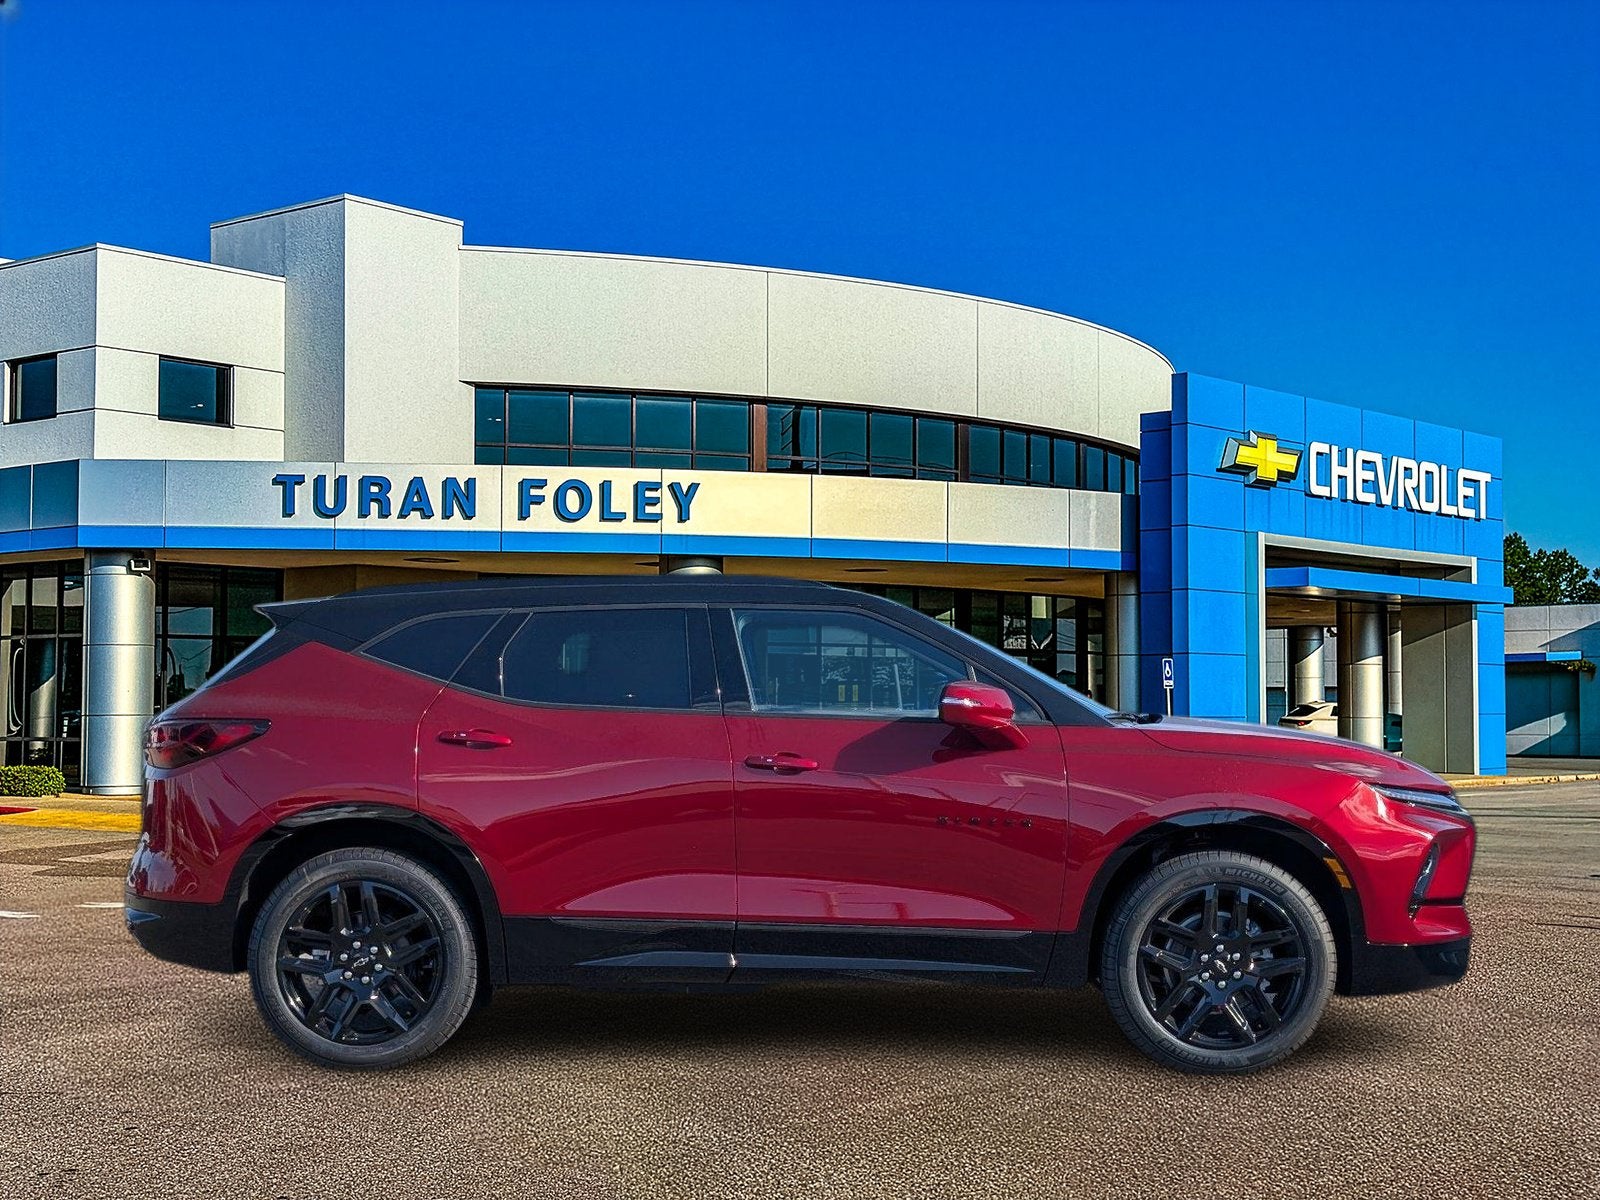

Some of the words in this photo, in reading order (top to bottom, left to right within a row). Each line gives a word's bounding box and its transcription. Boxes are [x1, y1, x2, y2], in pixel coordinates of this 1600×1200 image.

[272, 474, 477, 520] TURAN
[517, 478, 700, 523] FOLEY
[1309, 441, 1492, 520] CHEVROLET
[1225, 867, 1286, 895] MICHELIN
